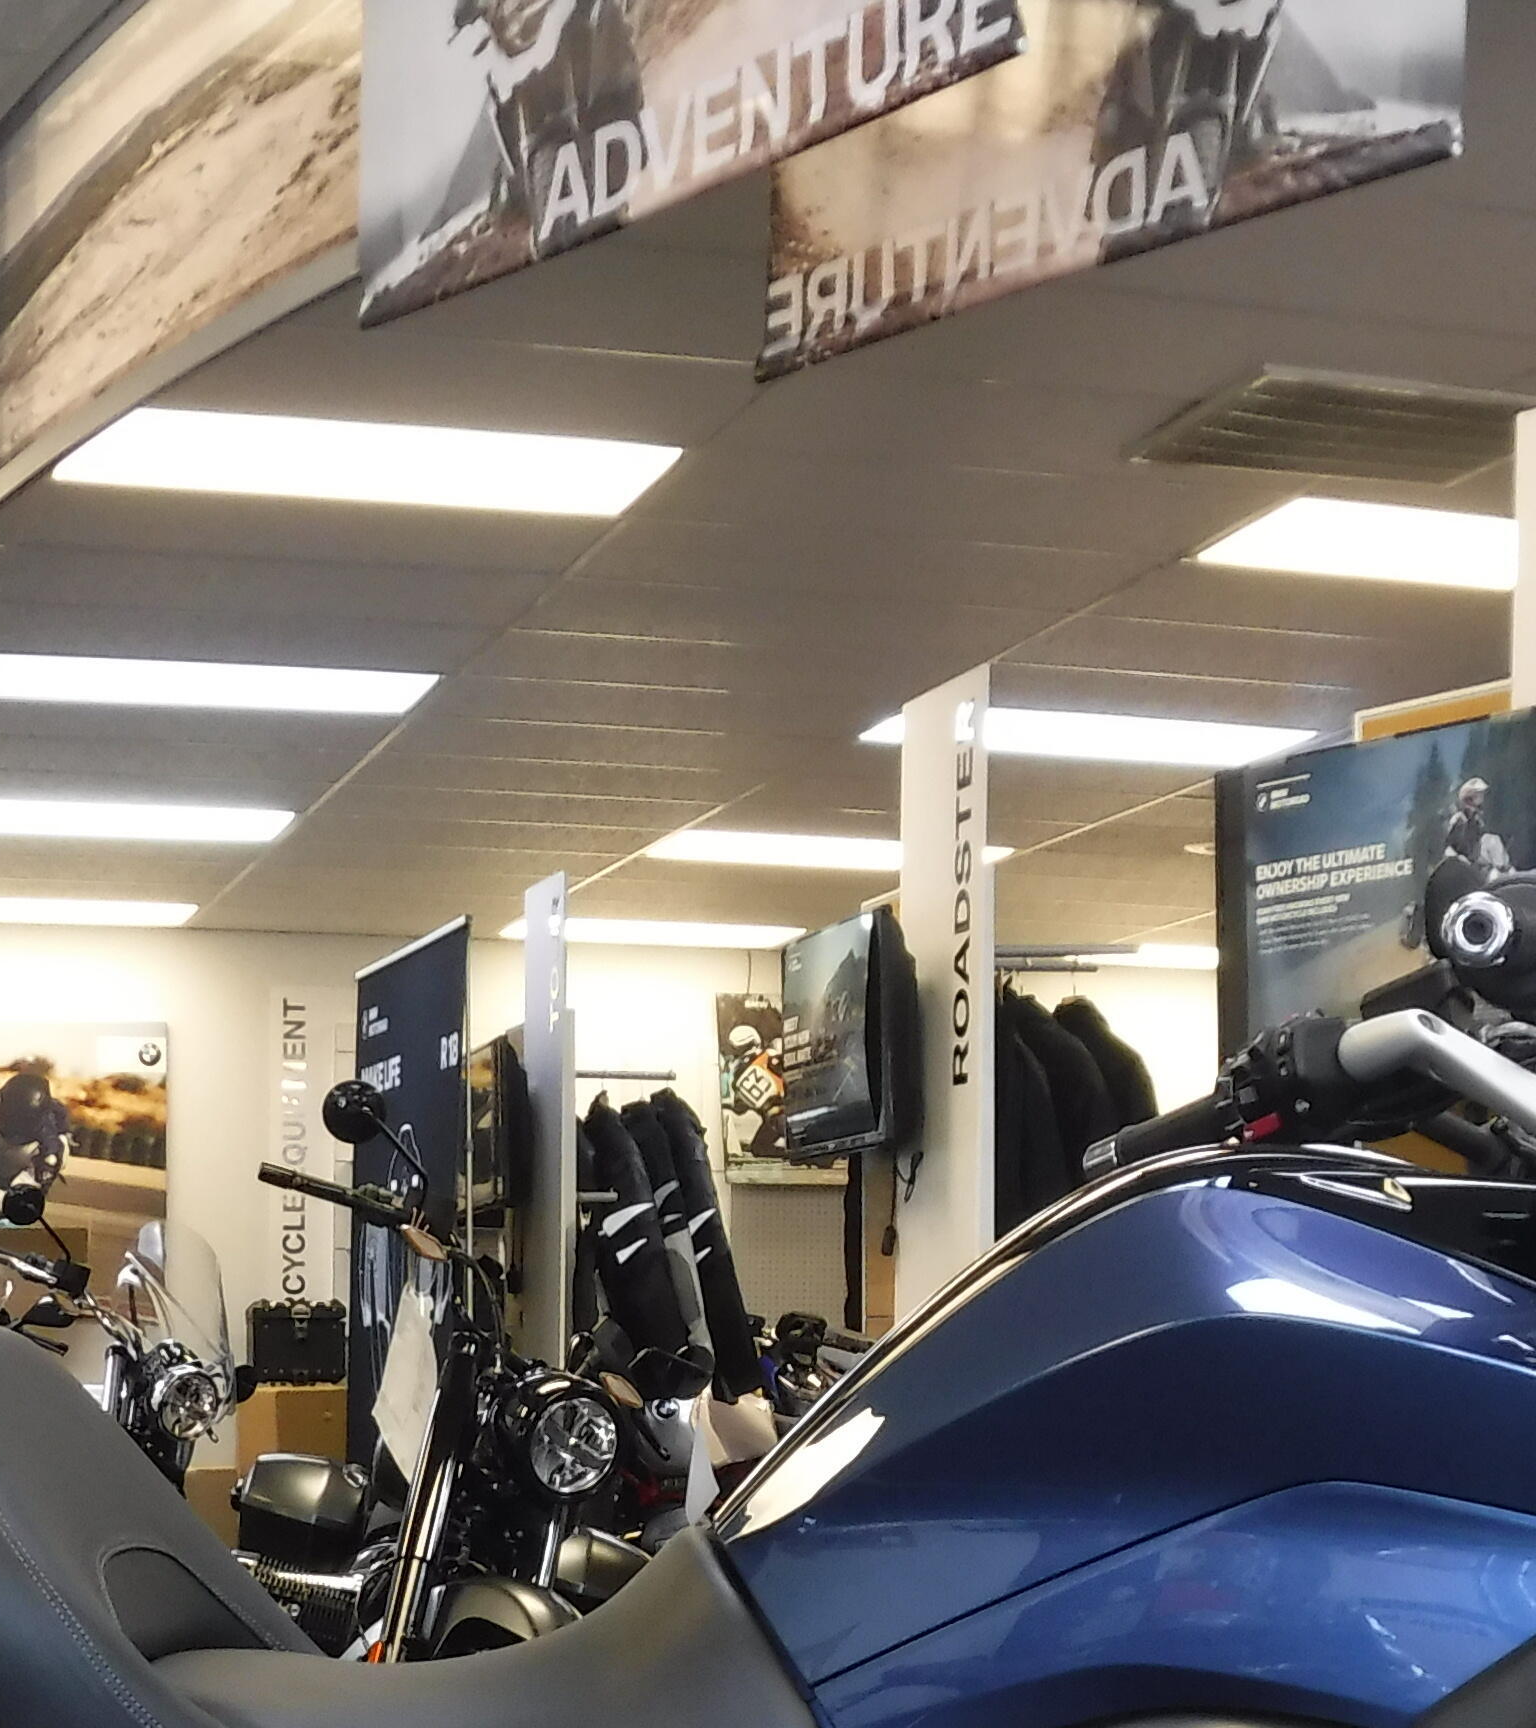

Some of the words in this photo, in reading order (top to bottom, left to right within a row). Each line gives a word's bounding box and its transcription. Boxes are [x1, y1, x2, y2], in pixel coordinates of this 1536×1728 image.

[539, 0, 1019, 240] ADVENTURE
[951, 697, 976, 1086] ROADSTER
[1255, 860, 1297, 882] ENJOY
[1296, 854, 1322, 875] THE
[1322, 843, 1387, 869] ULTIMATE
[1256, 872, 1329, 900] OWNERSHIP
[1330, 858, 1414, 888] EXPERIENCE
[282, 1193, 306, 1308] CYCLE
